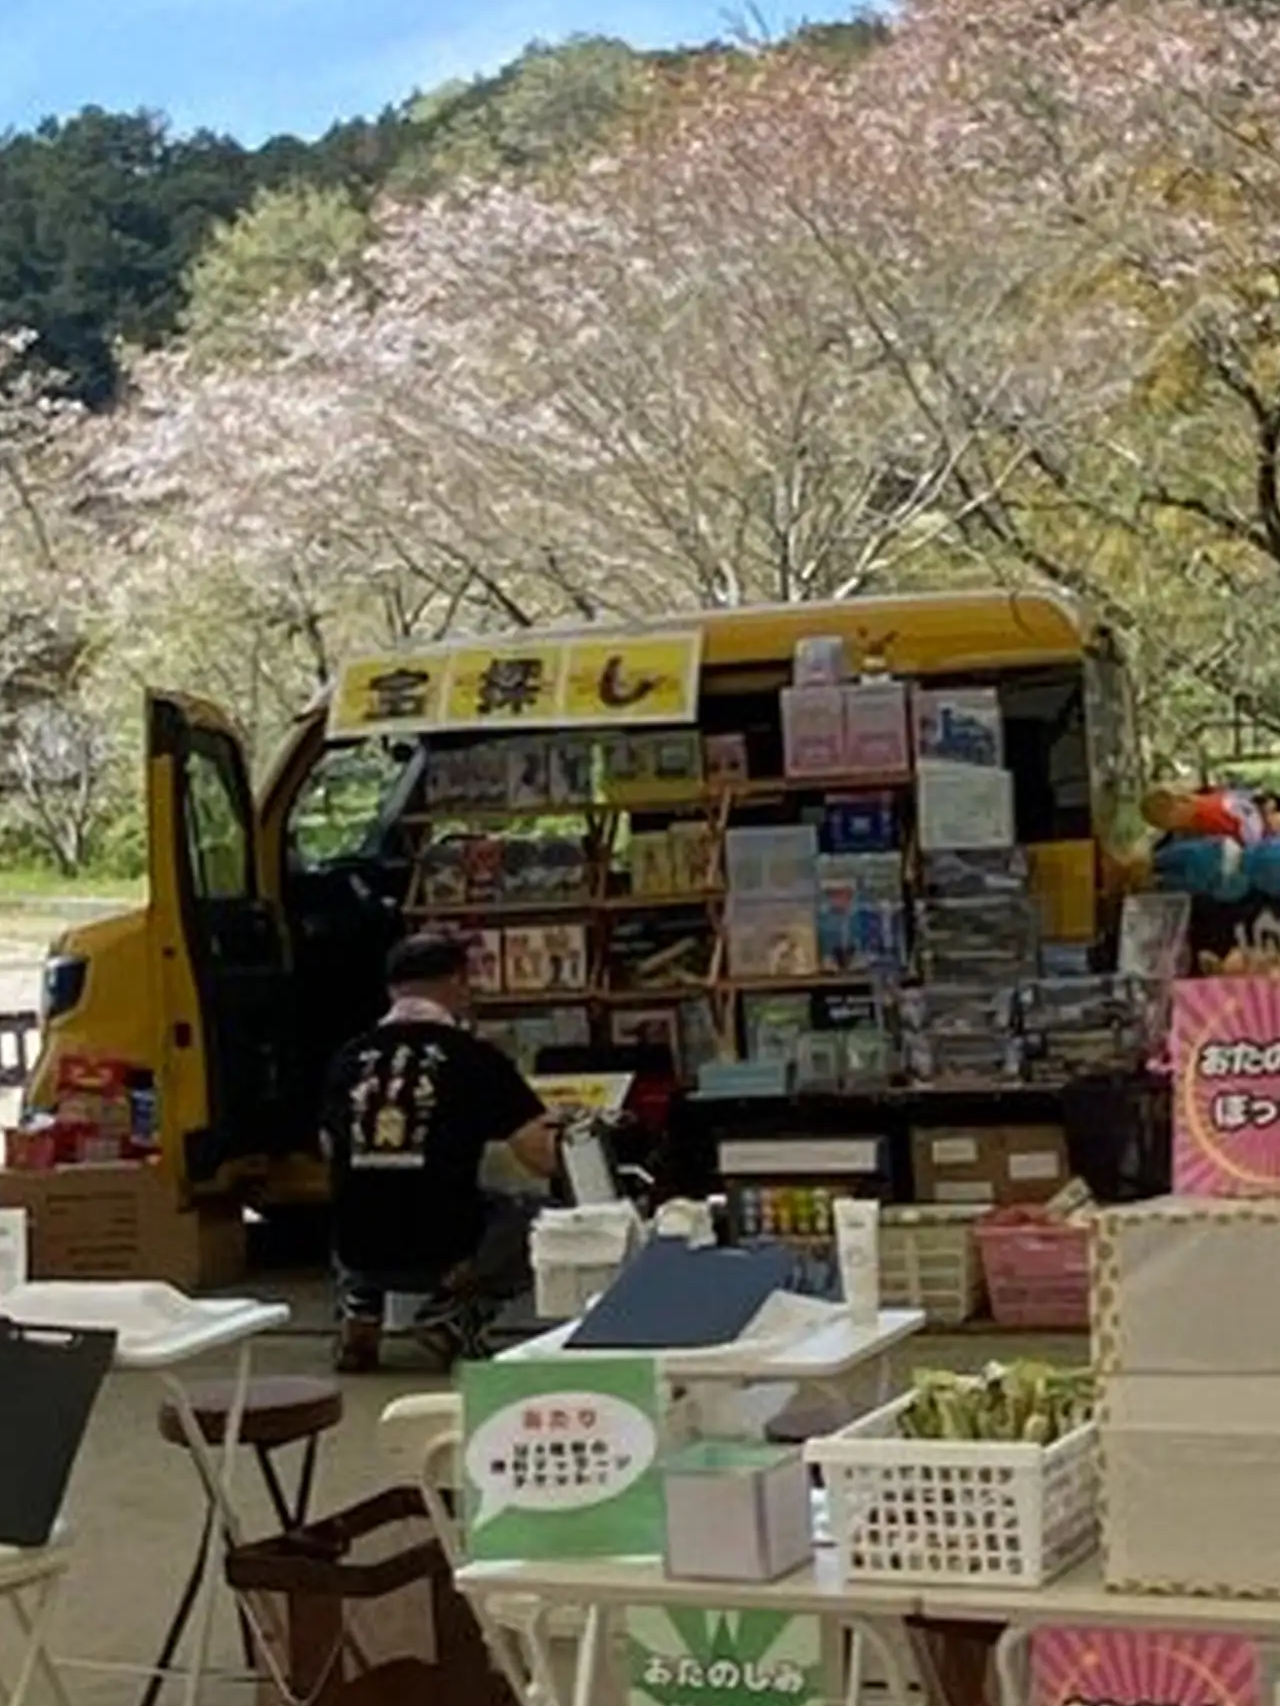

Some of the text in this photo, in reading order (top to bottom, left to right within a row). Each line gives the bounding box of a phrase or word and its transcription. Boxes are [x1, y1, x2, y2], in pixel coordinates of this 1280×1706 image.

[643, 1657, 805, 1694] おたのしみ
